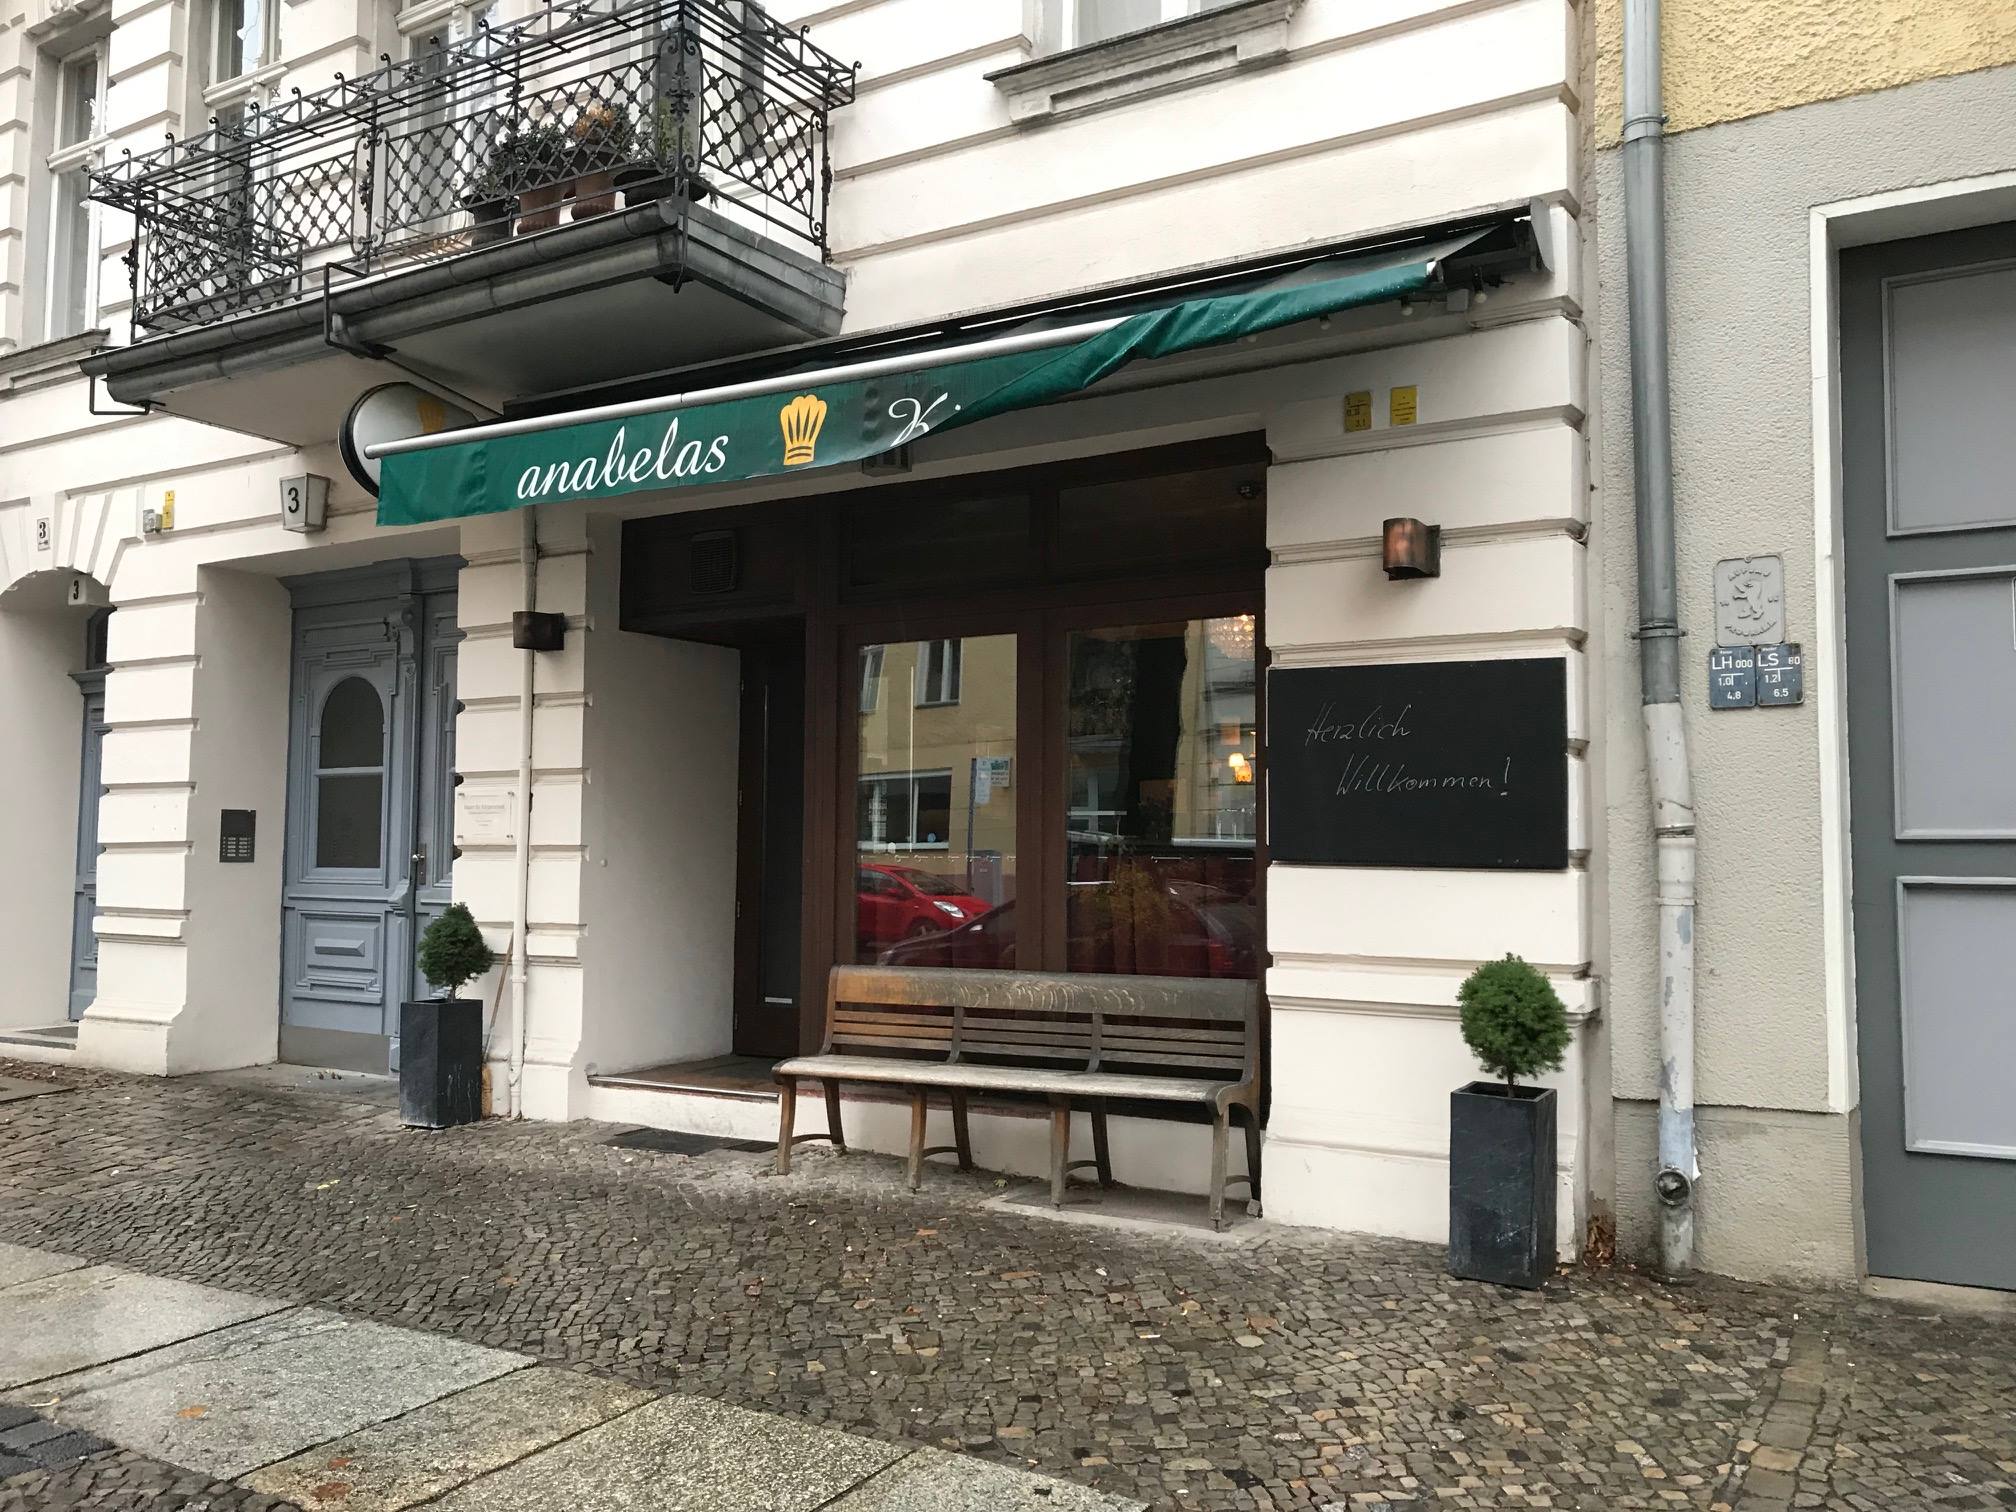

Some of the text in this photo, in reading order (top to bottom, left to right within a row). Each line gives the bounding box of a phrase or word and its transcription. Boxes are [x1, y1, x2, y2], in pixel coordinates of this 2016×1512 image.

[516, 417, 729, 500] anabelas
[287, 487, 301, 514] 3
[38, 521, 47, 539] 3
[72, 579, 81, 600] 3
[1712, 655, 1733, 670] LH
[1757, 653, 1779, 667] LS
[1764, 674, 1778, 683] 1.2
[1727, 691, 1742, 700] 4.8
[1773, 688, 1789, 697] 6.5
[1305, 701, 1413, 747] Herzlich
